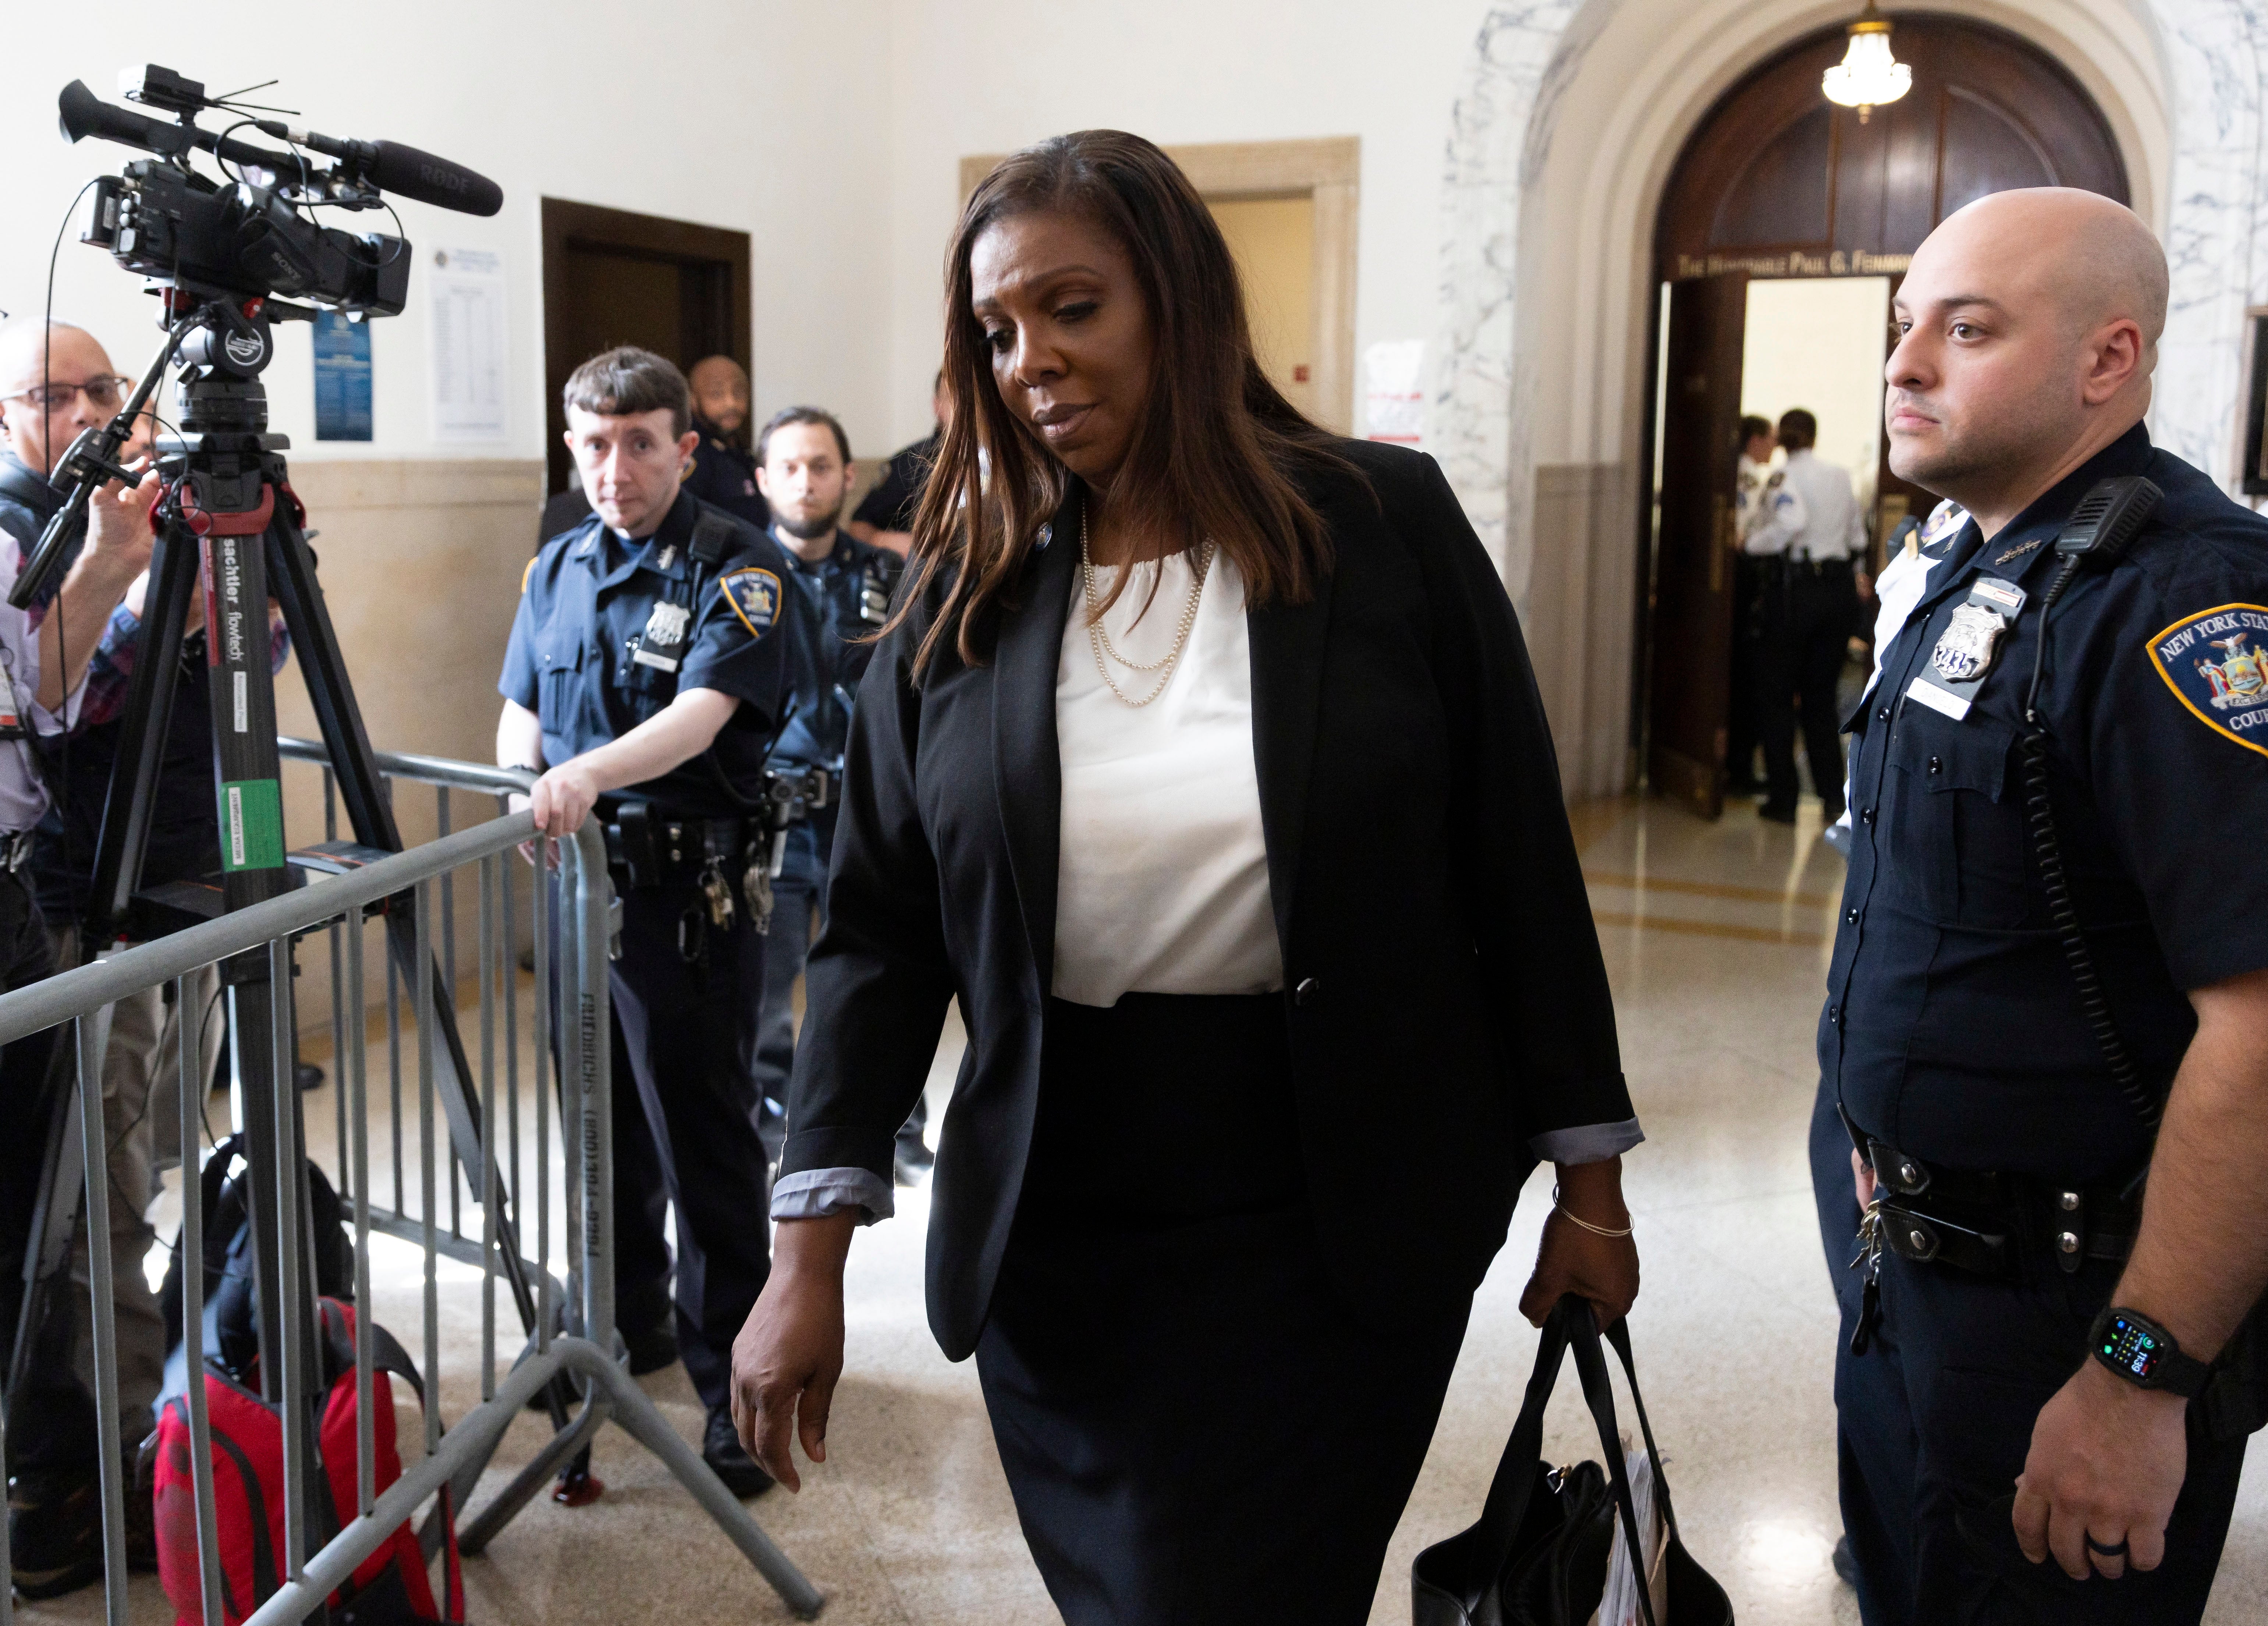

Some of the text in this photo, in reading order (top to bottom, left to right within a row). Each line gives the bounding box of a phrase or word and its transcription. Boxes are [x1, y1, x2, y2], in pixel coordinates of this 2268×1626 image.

[271, 252, 302, 280] SONY
[223, 538, 244, 661] sachtler flowtech
[2159, 628, 2195, 662] NEW
[2193, 613, 2240, 638] YORK
[2131, 1351, 2148, 1373] 11:39
